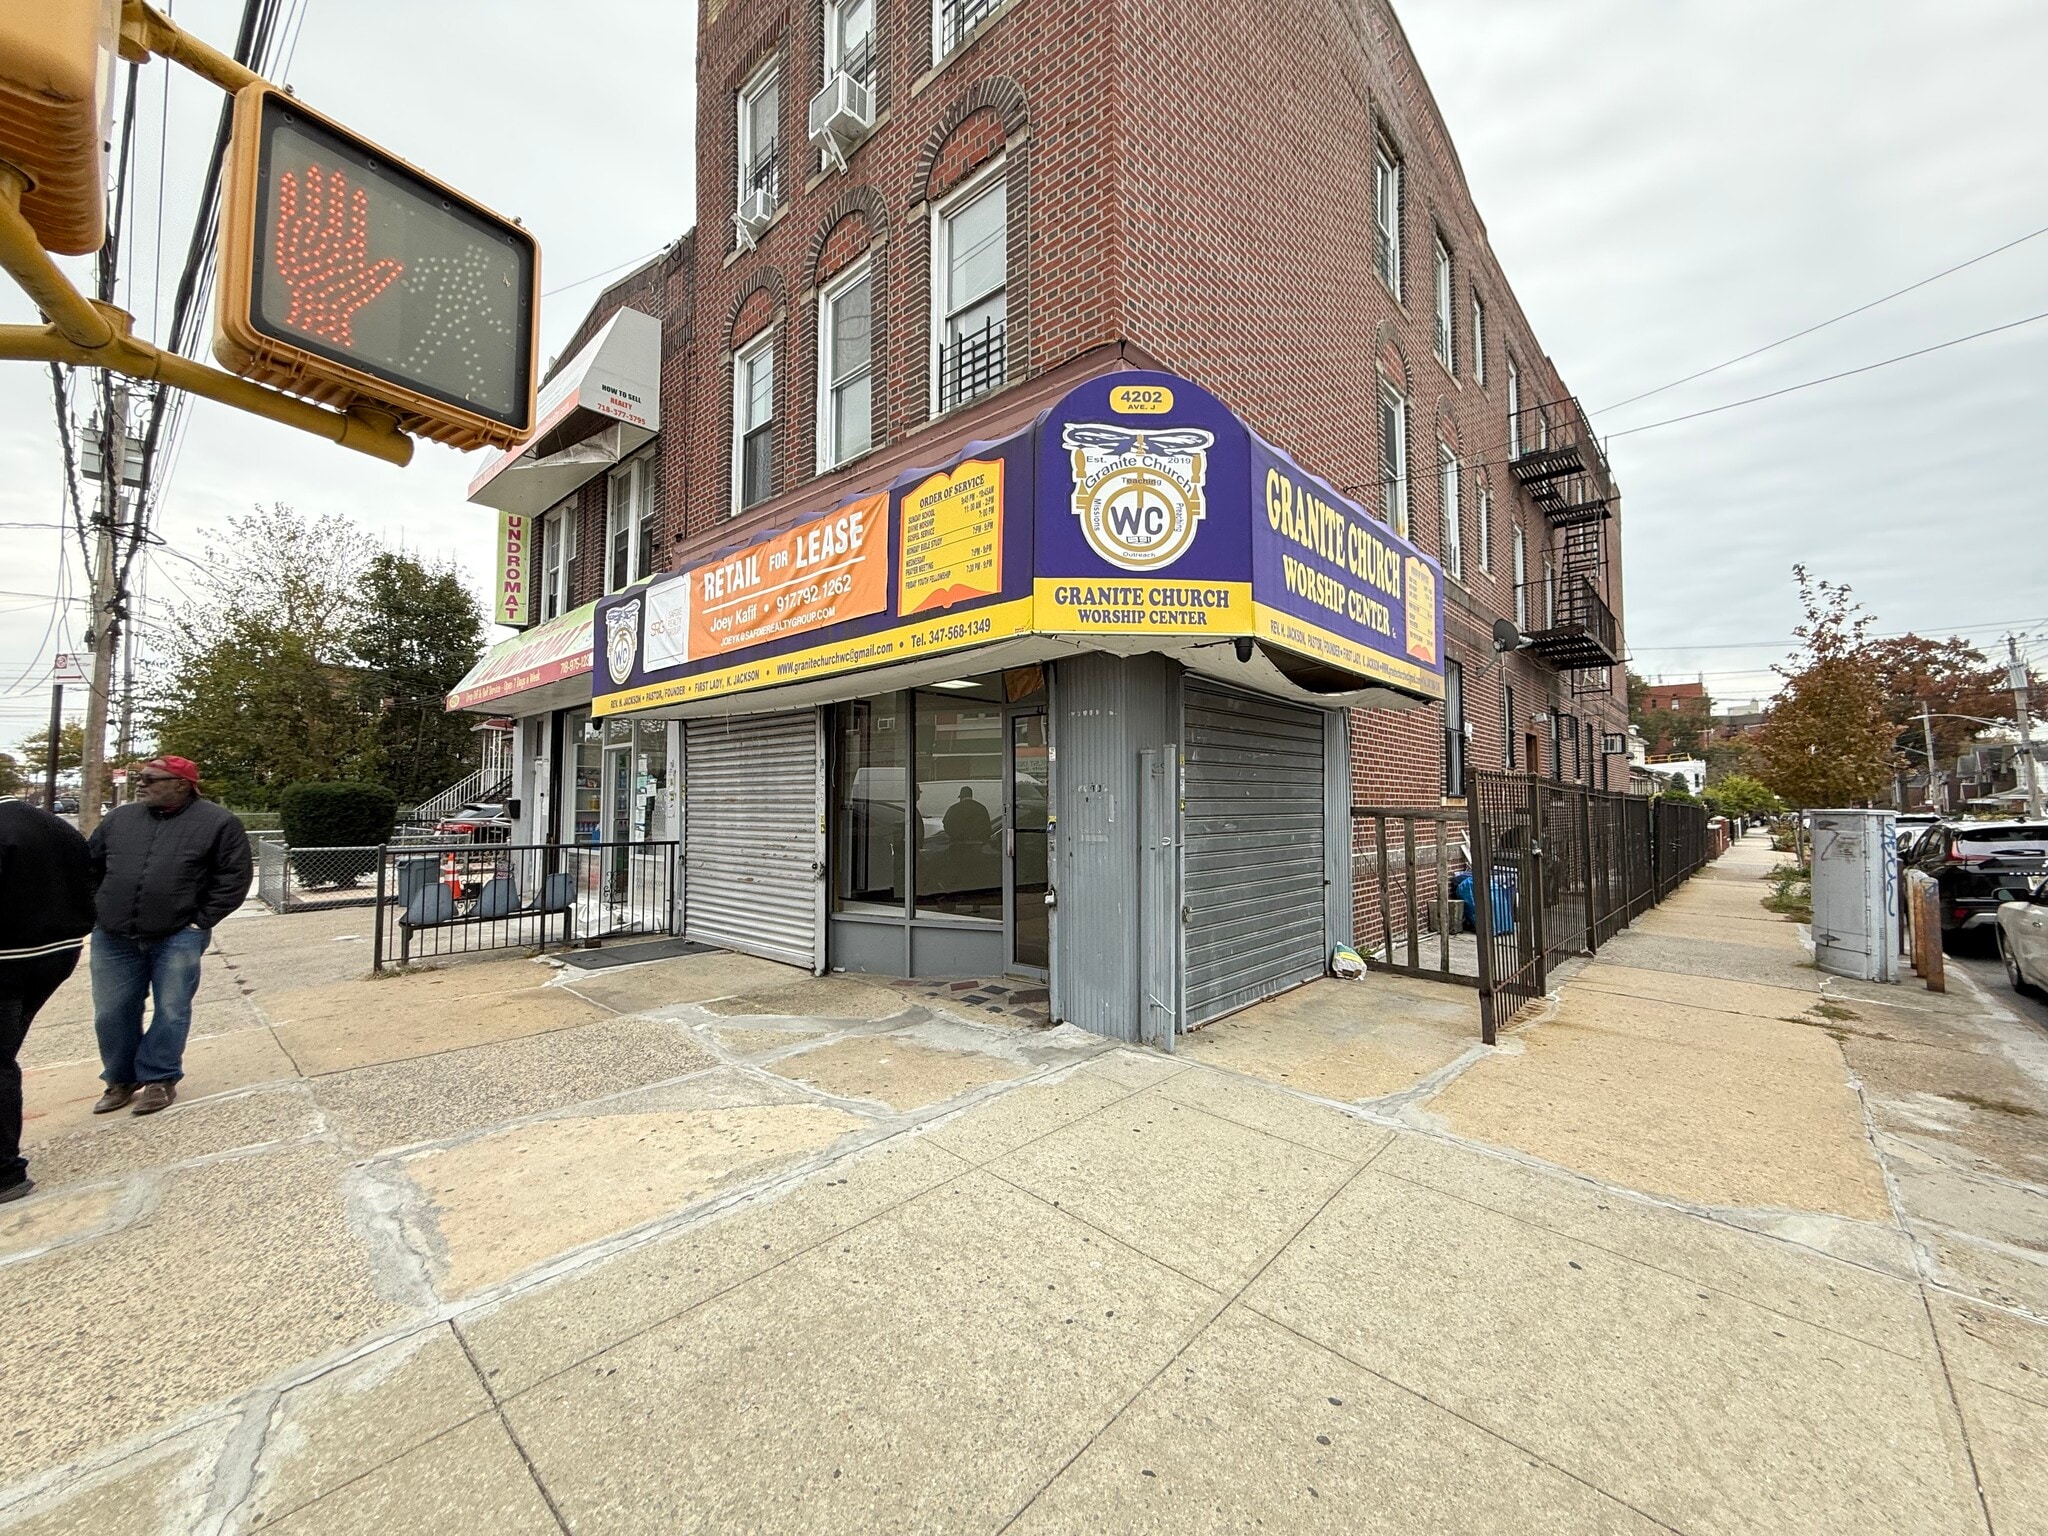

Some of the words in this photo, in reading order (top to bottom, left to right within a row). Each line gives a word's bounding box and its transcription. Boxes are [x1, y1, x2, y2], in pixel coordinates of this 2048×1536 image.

[601, 384, 618, 395] HOW
[619, 390, 627, 398] TO
[628, 394, 642, 404] SELL
[610, 397, 633, 410] REALTY
[1121, 391, 1163, 403] 4202
[597, 403, 646, 425] 718-377-3795
[1086, 456, 1107, 464] Est.
[1167, 457, 1191, 465] 2019
[1085, 456, 1137, 489] Granite
[1142, 455, 1193, 494] Church
[1121, 476, 1162, 486] Teaching
[920, 491, 942, 508] ORDER
[944, 486, 952, 498] OF
[954, 474, 985, 495] SERVICE
[1110, 506, 1163, 536] WC
[1175, 503, 1184, 533] Preaching
[1266, 468, 1346, 569] GRANITE
[1347, 522, 1401, 600] CHURCH
[504, 516, 522, 619] UNDROMAT
[703, 555, 761, 602] RETAIL
[768, 550, 789, 572] FOR
[796, 511, 863, 568] LEASE
[1055, 586, 1144, 606] GRANITE
[1148, 588, 1230, 608] CHURCH
[1282, 554, 1346, 615] WORSHIP
[1347, 589, 1390, 637] CENTER
[710, 617, 733, 633] Joey
[1078, 609, 1146, 624] WORSHIP
[1149, 610, 1207, 625] CENTER
[695, 682, 708, 693] FIRST
[733, 669, 759, 684] JACKSON
[911, 633, 926, 648] Tel.
[929, 617, 991, 644] 347-568-1349
